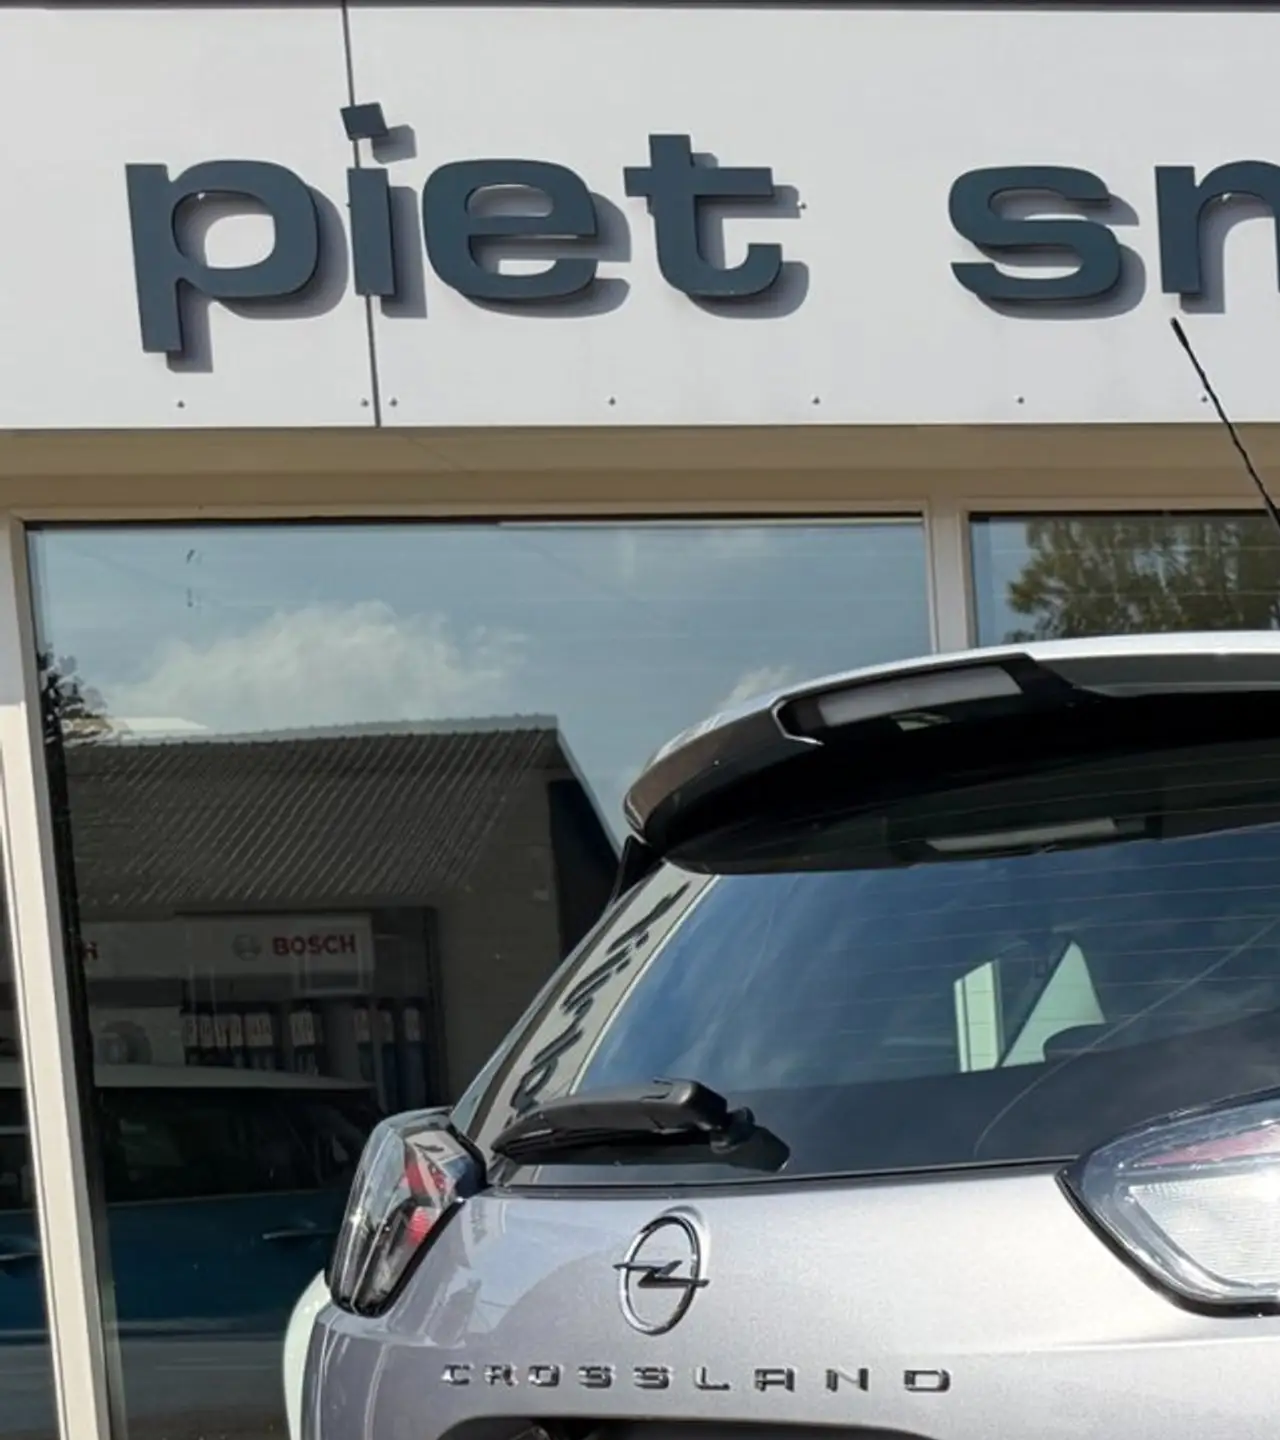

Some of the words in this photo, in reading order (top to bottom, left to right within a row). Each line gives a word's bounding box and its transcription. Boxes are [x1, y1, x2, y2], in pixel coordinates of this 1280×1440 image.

[125, 102, 783, 354] piet
[272, 933, 357, 957] BOSCH
[441, 1362, 952, 1393] CROSSLAND
